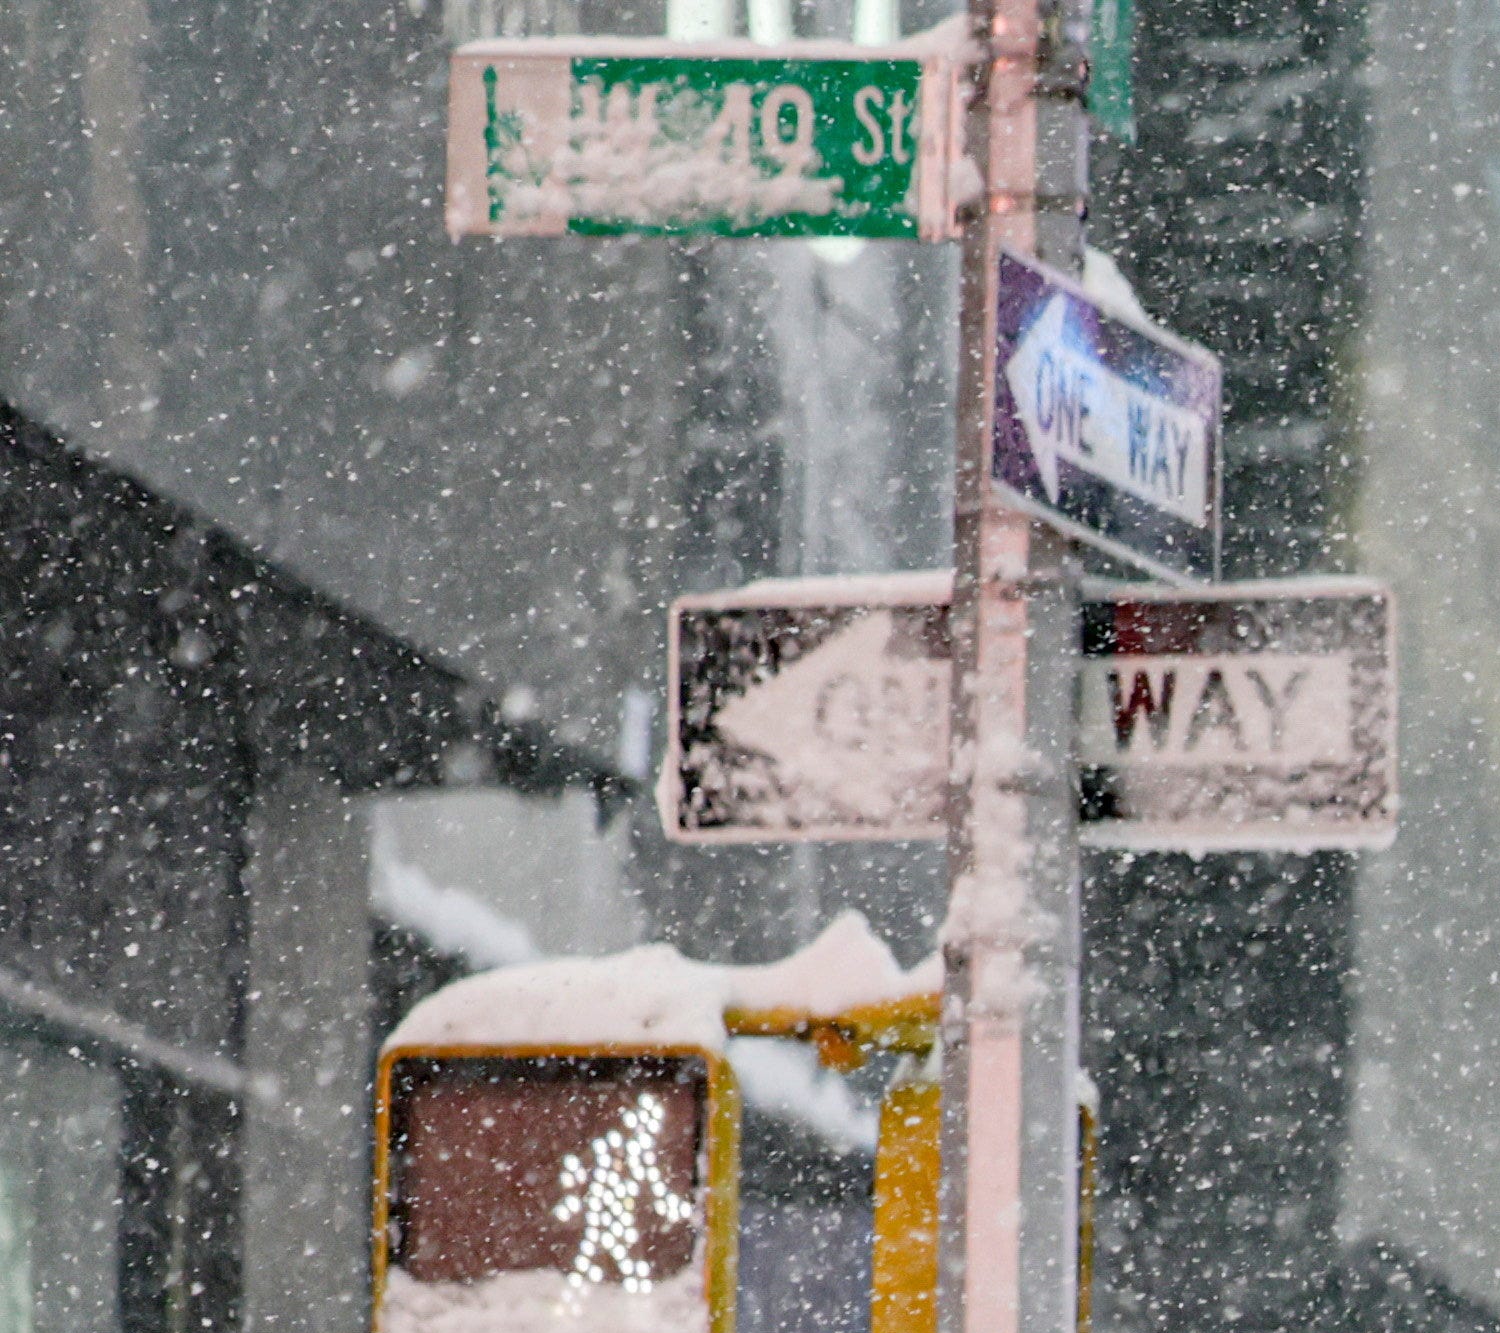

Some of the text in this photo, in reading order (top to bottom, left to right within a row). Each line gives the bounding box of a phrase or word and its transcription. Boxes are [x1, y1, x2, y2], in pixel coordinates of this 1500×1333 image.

[850, 83, 911, 166] St
[1035, 350, 1192, 499] ONE WAY
[1107, 667, 1312, 753] WAY
